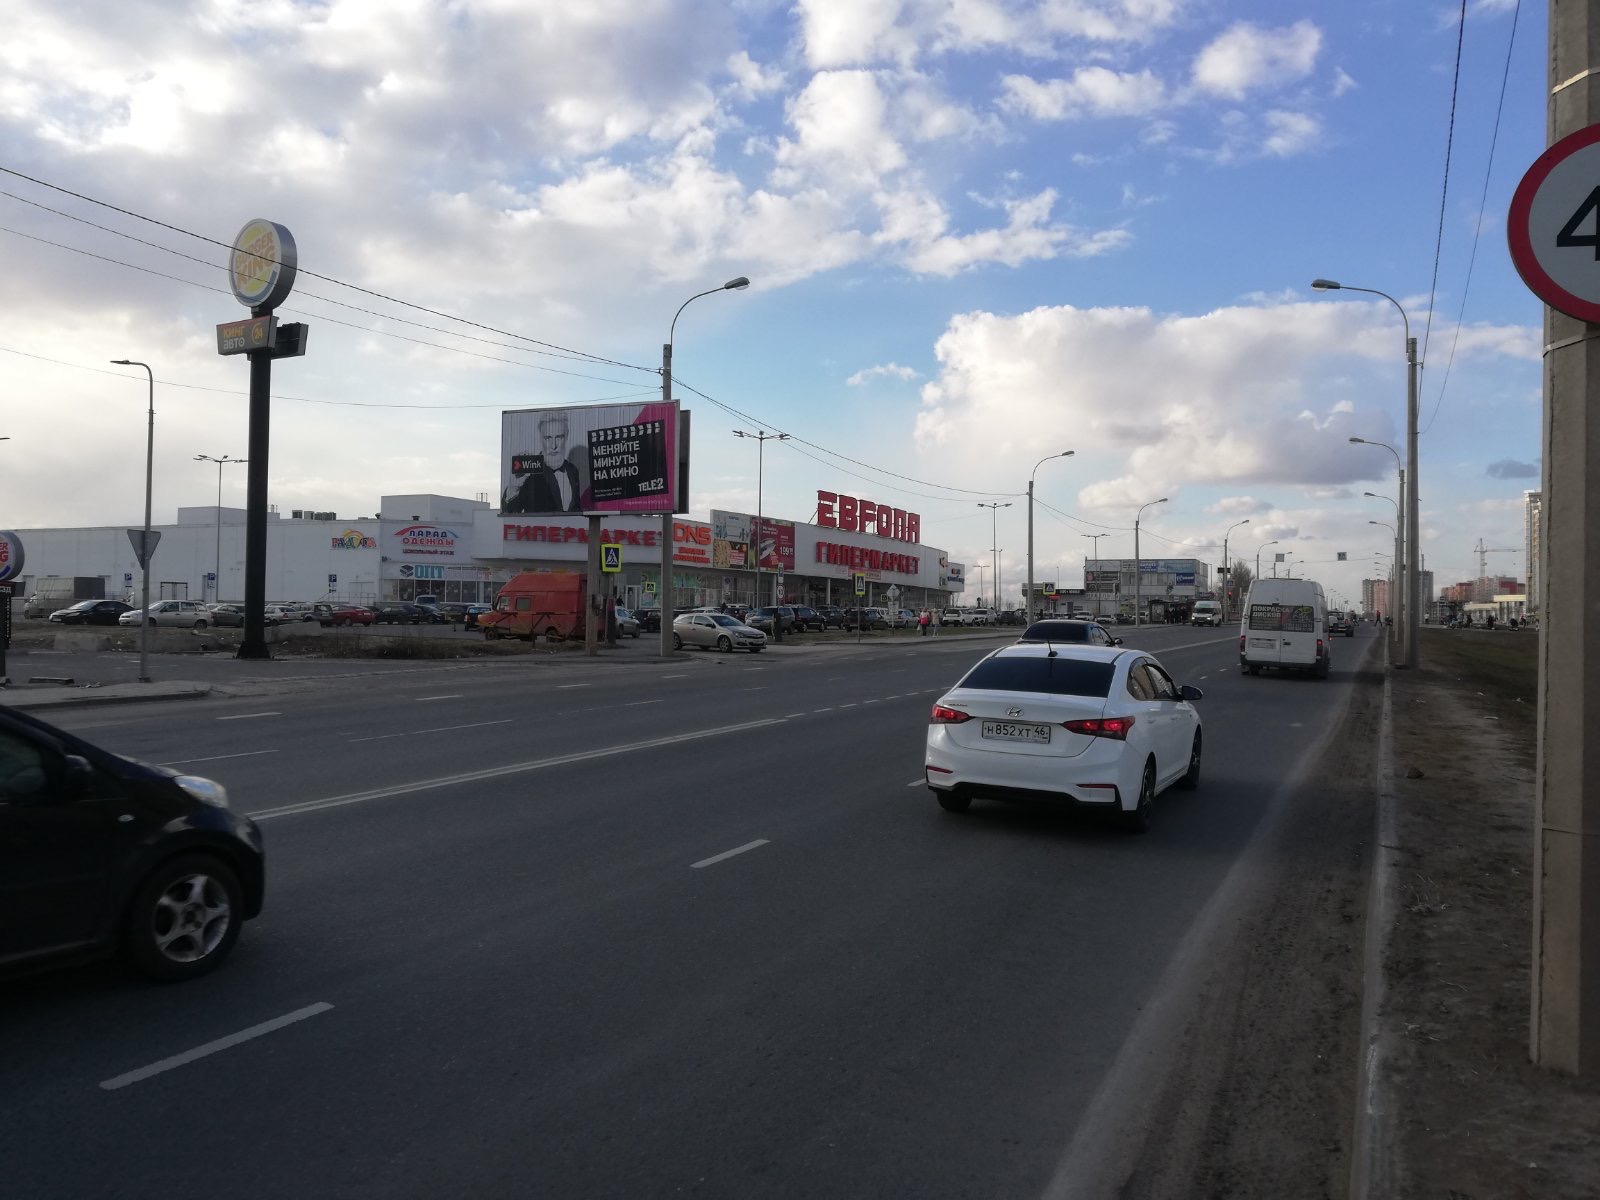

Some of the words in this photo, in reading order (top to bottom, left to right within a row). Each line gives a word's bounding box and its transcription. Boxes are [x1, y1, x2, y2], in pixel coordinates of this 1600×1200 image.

[592, 440, 640, 456] МЕНЯЙТЕ
[522, 460, 542, 469] Wink
[593, 453, 638, 468] МИНУТЫ
[594, 468, 608, 480] НА
[610, 466, 639, 479] КИНО
[638, 478, 664, 492] TELE2
[817, 490, 920, 543] ЕВРОПА
[409, 530, 448, 538] ПАРАД
[503, 524, 662, 547] ГИПЕРМАРКЕ
[673, 523, 712, 545] DNS
[402, 538, 454, 546] ОДЕЖДЫ
[816, 541, 920, 575] ГИПЕРМАРКЕТ
